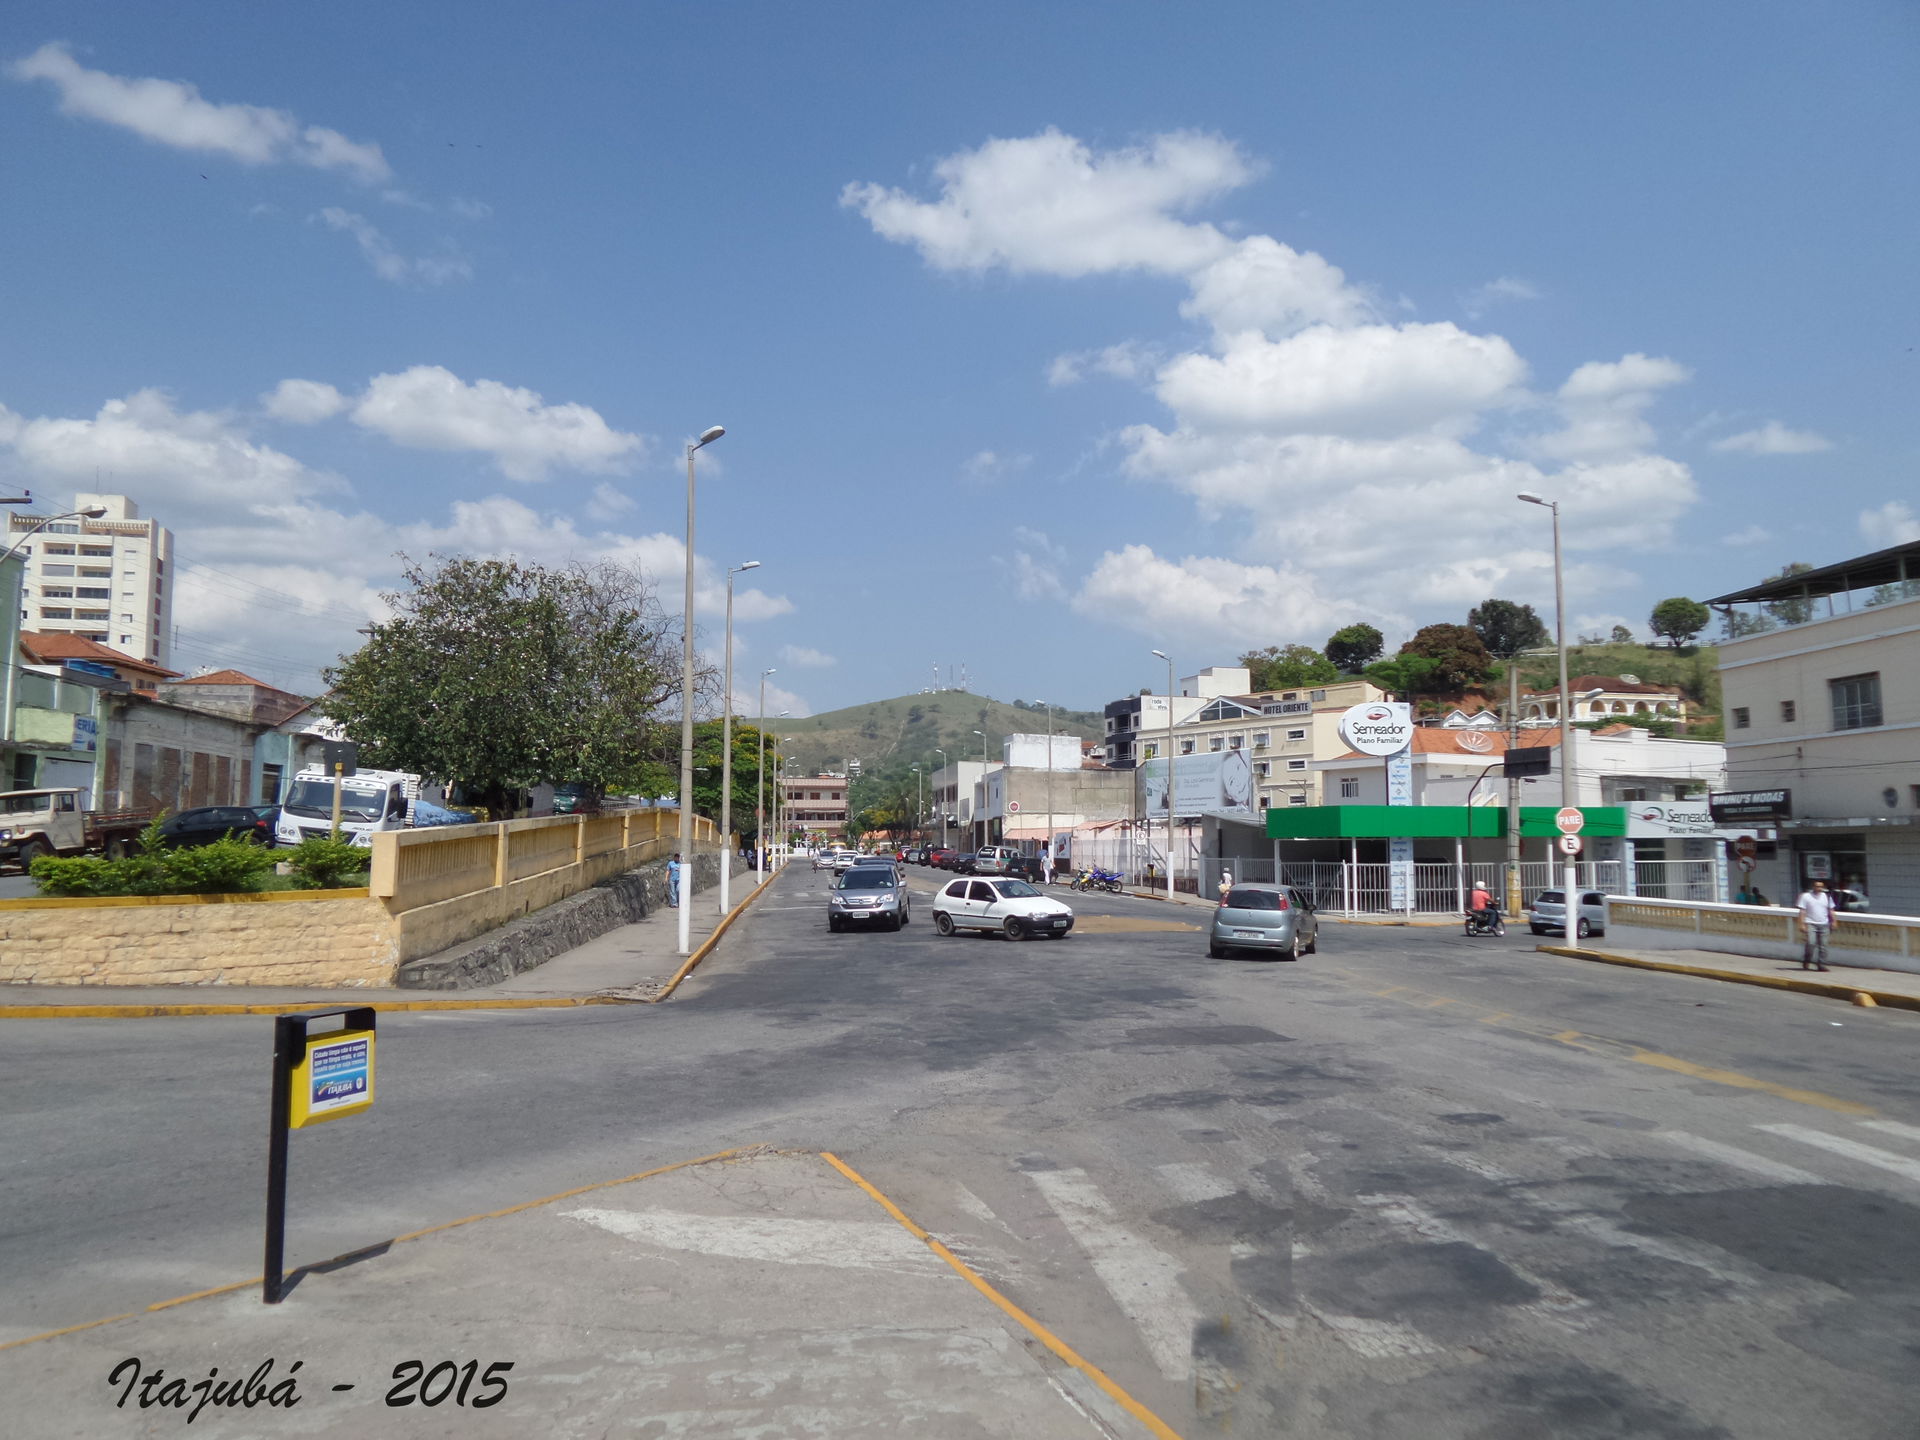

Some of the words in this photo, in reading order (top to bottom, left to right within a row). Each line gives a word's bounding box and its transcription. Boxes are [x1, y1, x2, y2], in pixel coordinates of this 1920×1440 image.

[1263, 704, 1282, 715] HOTEL
[1282, 702, 1309, 713] ORIENTE
[1352, 722, 1406, 735] Semeador
[1752, 791, 1785, 803] MODAS
[1558, 815, 1581, 826] PARE
[1667, 808, 1713, 823] Semeado
[1567, 838, 1575, 850] E
